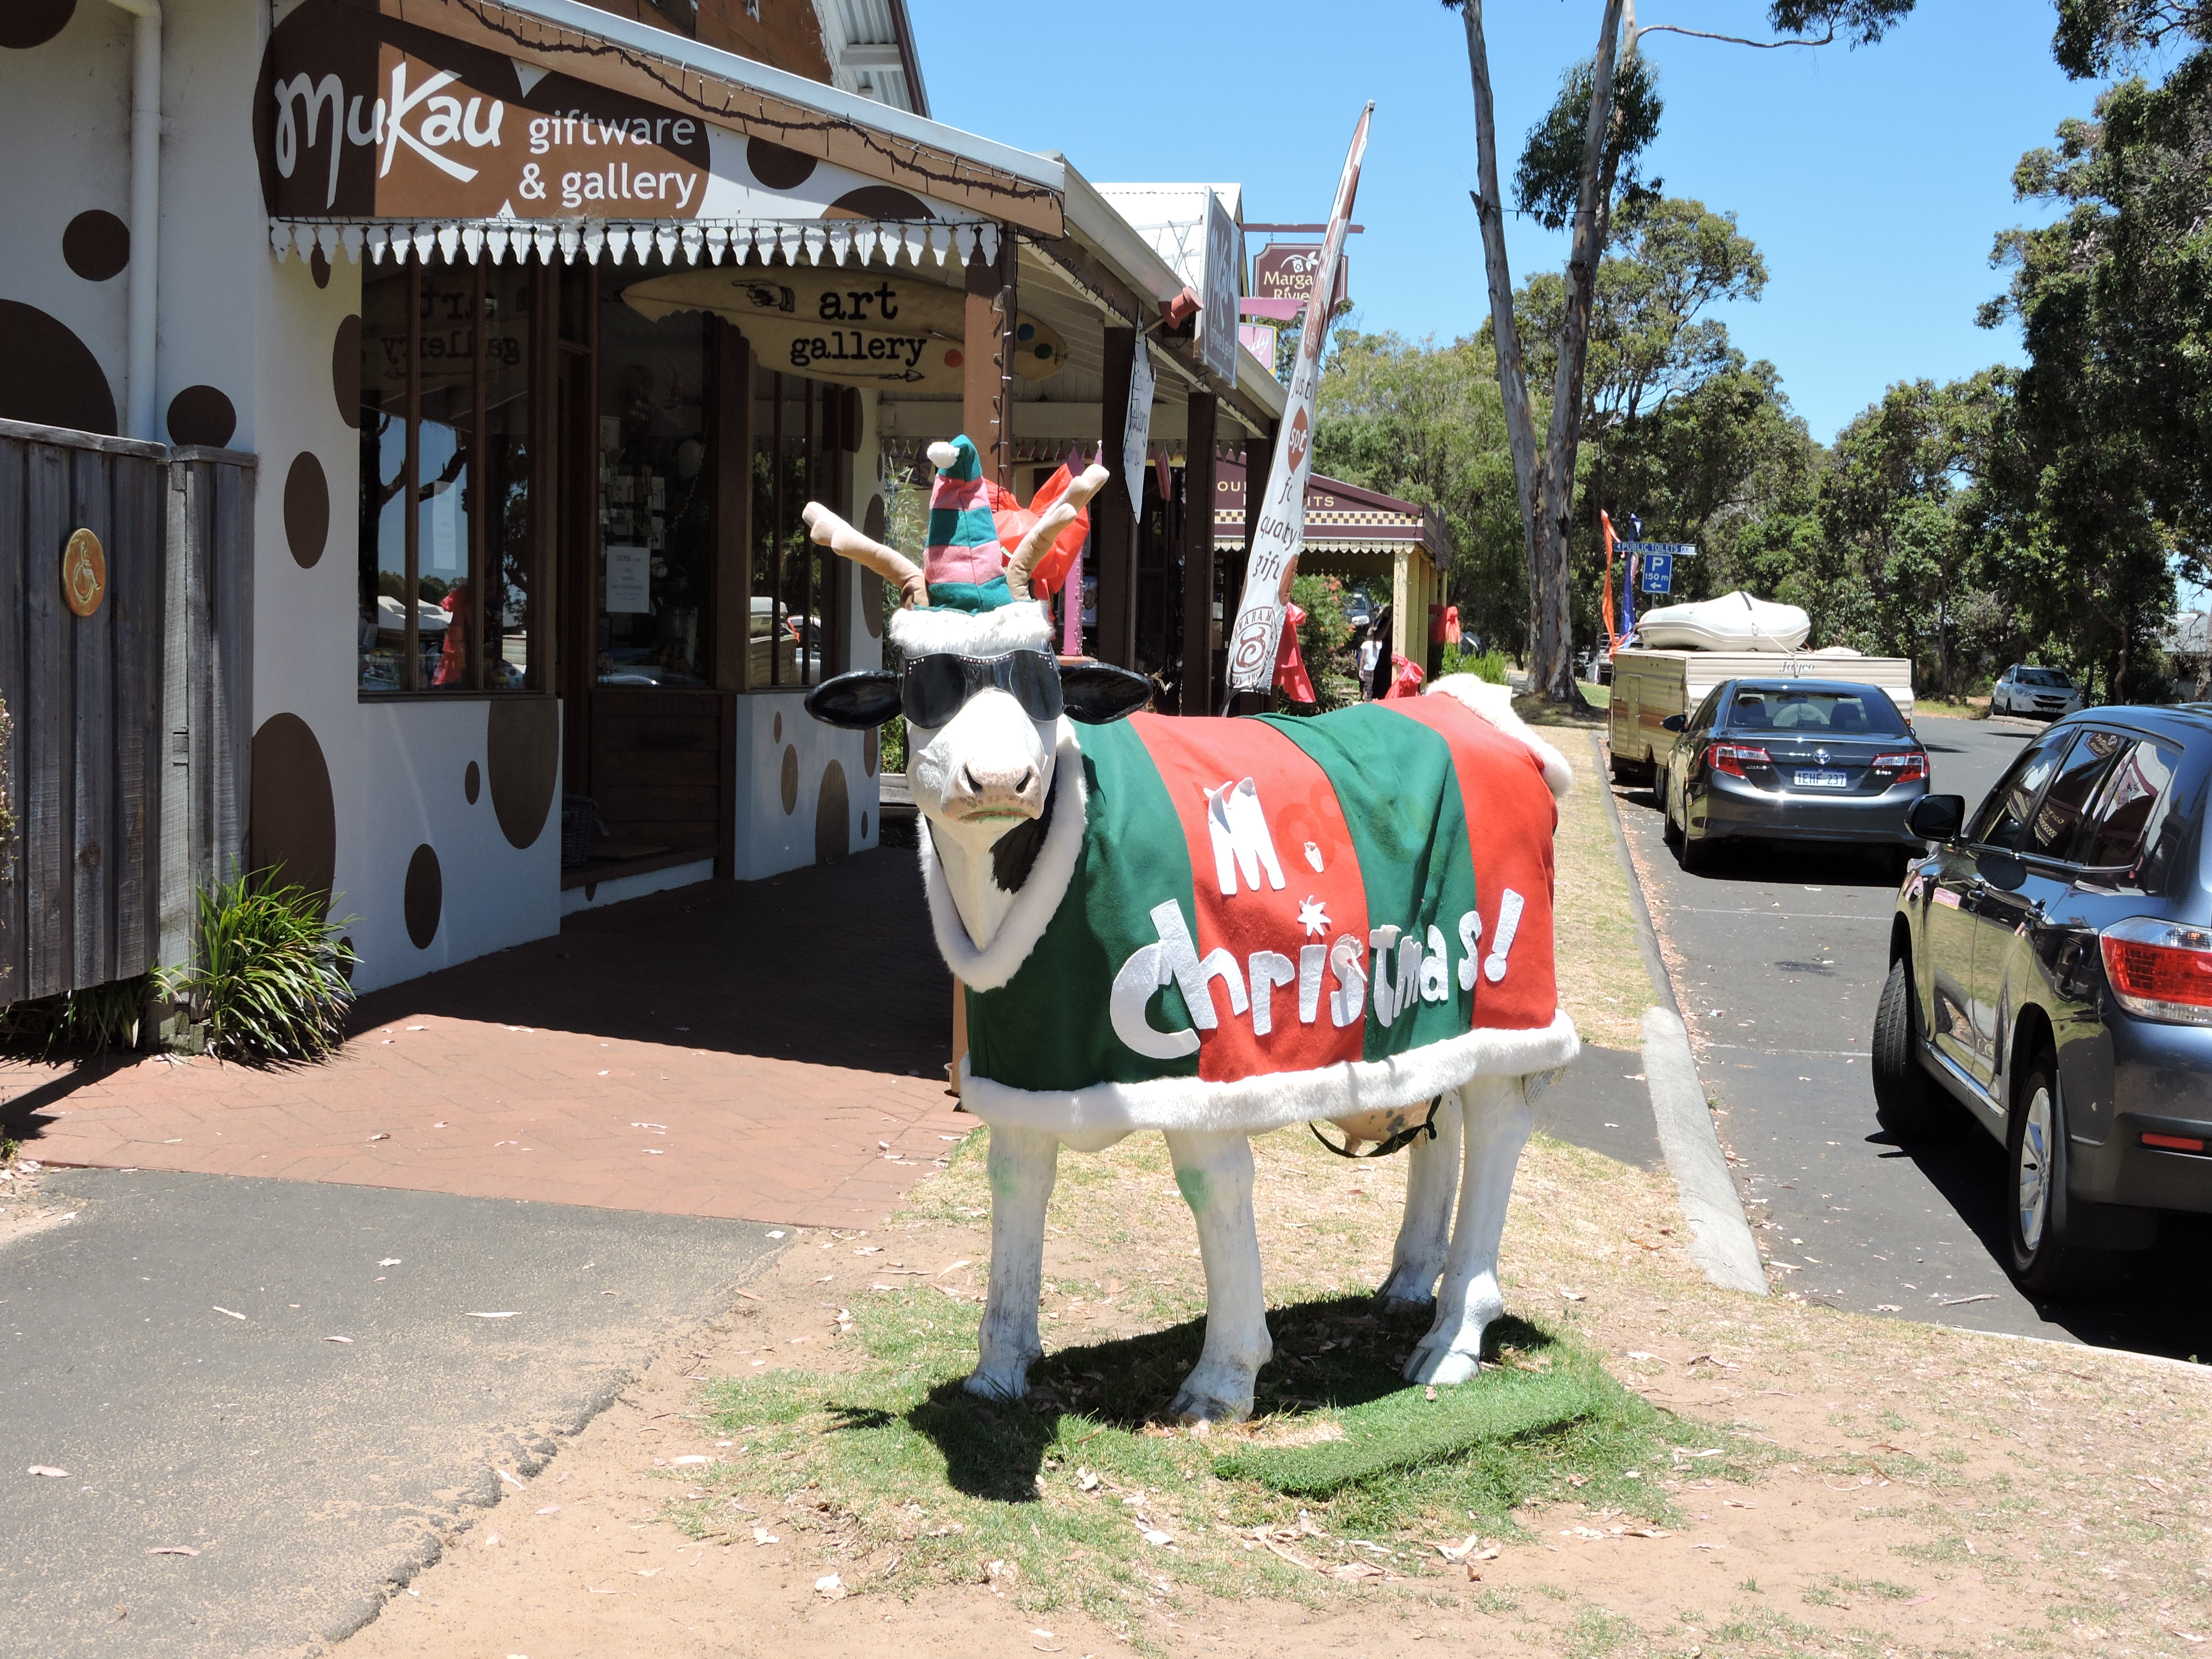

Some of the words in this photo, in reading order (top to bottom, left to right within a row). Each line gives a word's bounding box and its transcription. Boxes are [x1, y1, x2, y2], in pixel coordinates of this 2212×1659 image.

[529, 109, 695, 154] giftware
[519, 163, 546, 199] &
[561, 163, 697, 208] gallery
[1263, 272, 1314, 289] Marga
[819, 282, 898, 320] art
[790, 331, 927, 366] gallery
[1622, 543, 1648, 551] PUBLIC
[1650, 544, 1678, 553] TOILETS
[1652, 557, 1664, 571] P
[1798, 773, 1820, 784] 1EHF
[1827, 774, 1844, 785] 237
